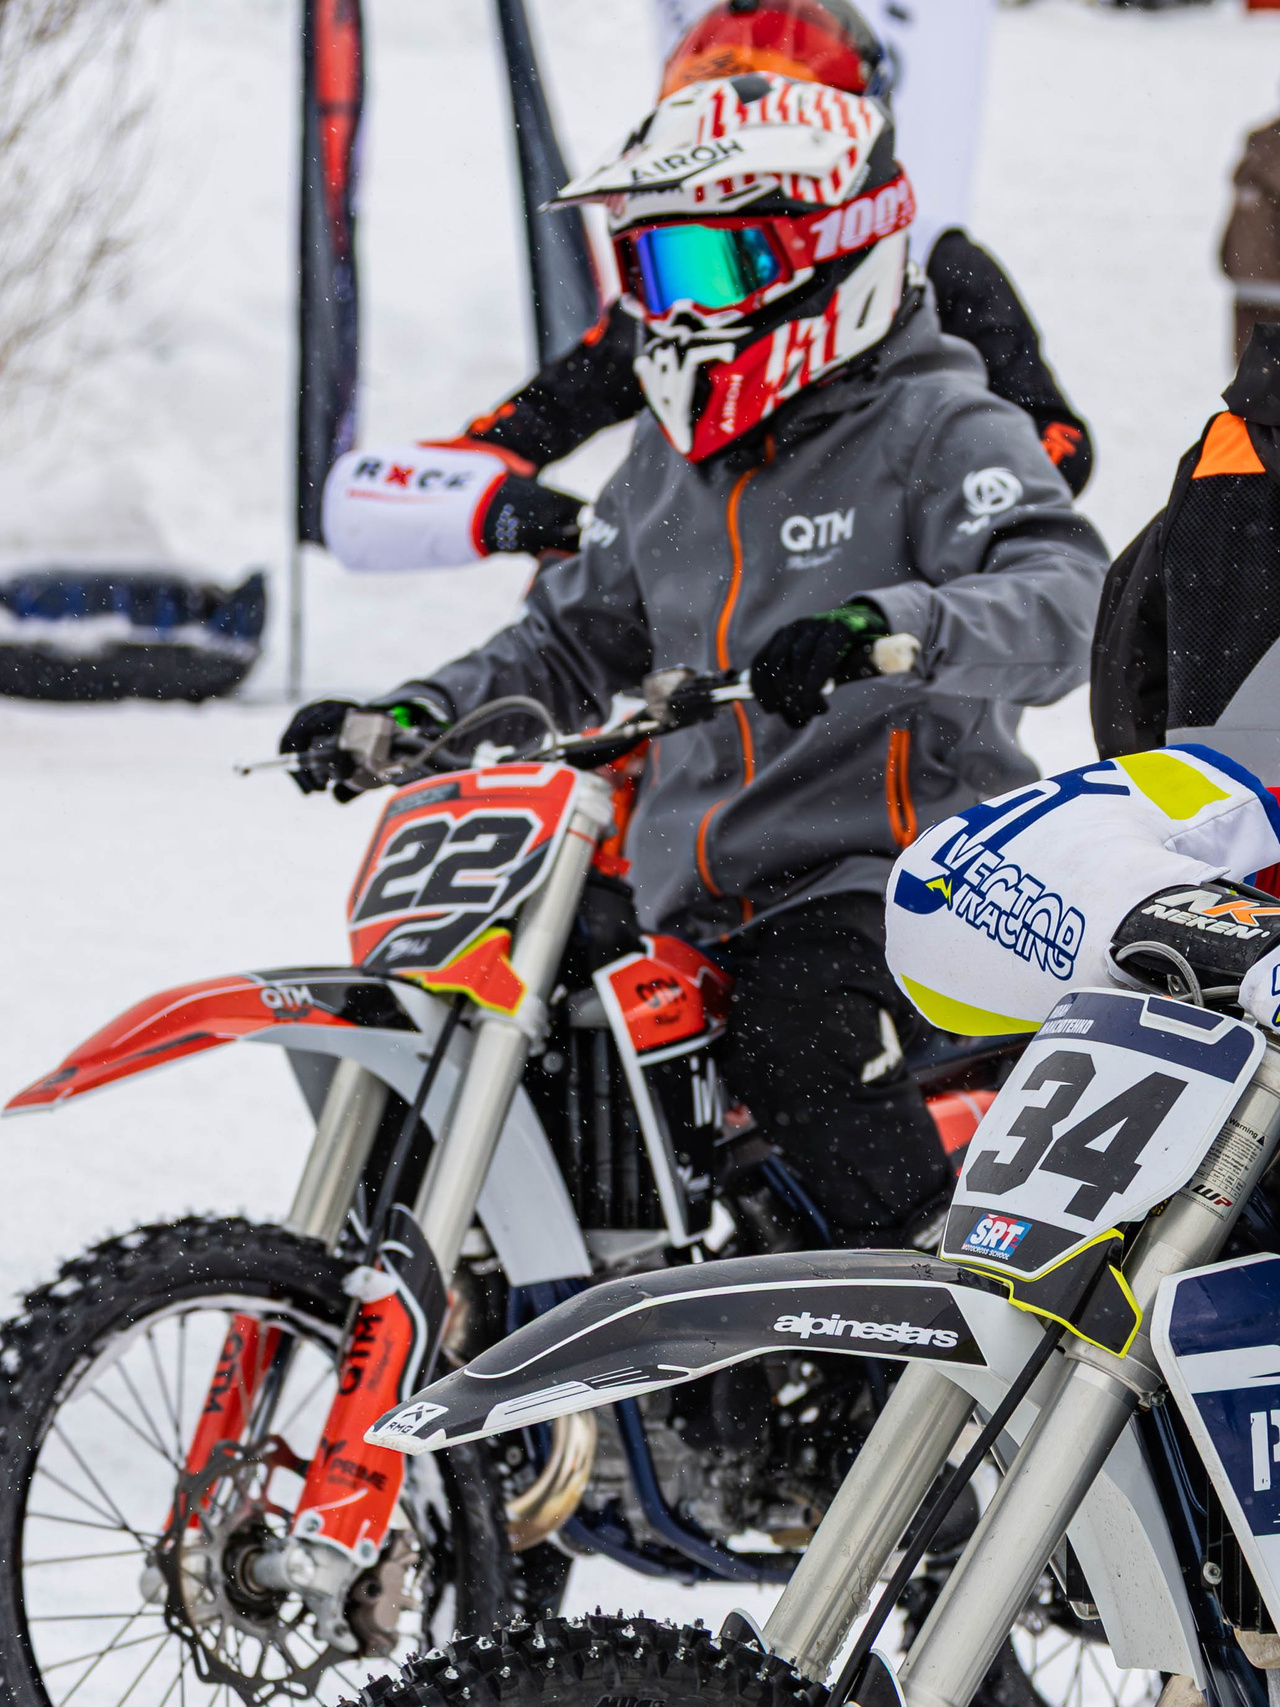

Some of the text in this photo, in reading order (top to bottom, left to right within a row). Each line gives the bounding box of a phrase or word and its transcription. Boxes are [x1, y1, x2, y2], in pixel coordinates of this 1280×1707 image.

[630, 139, 744, 182] AIROH
[780, 507, 856, 552] QTM
[354, 815, 535, 922] 22
[942, 831, 1086, 962] VECTOR
[955, 884, 1075, 981] RACING
[1141, 904, 1264, 940] NEKEN
[966, 1049, 1189, 1222] 34
[1229, 1117, 1259, 1140] Warning
[1191, 1184, 1233, 1207] WP
[970, 1218, 1025, 1251] SRT
[773, 1311, 959, 1348] alpinestars
